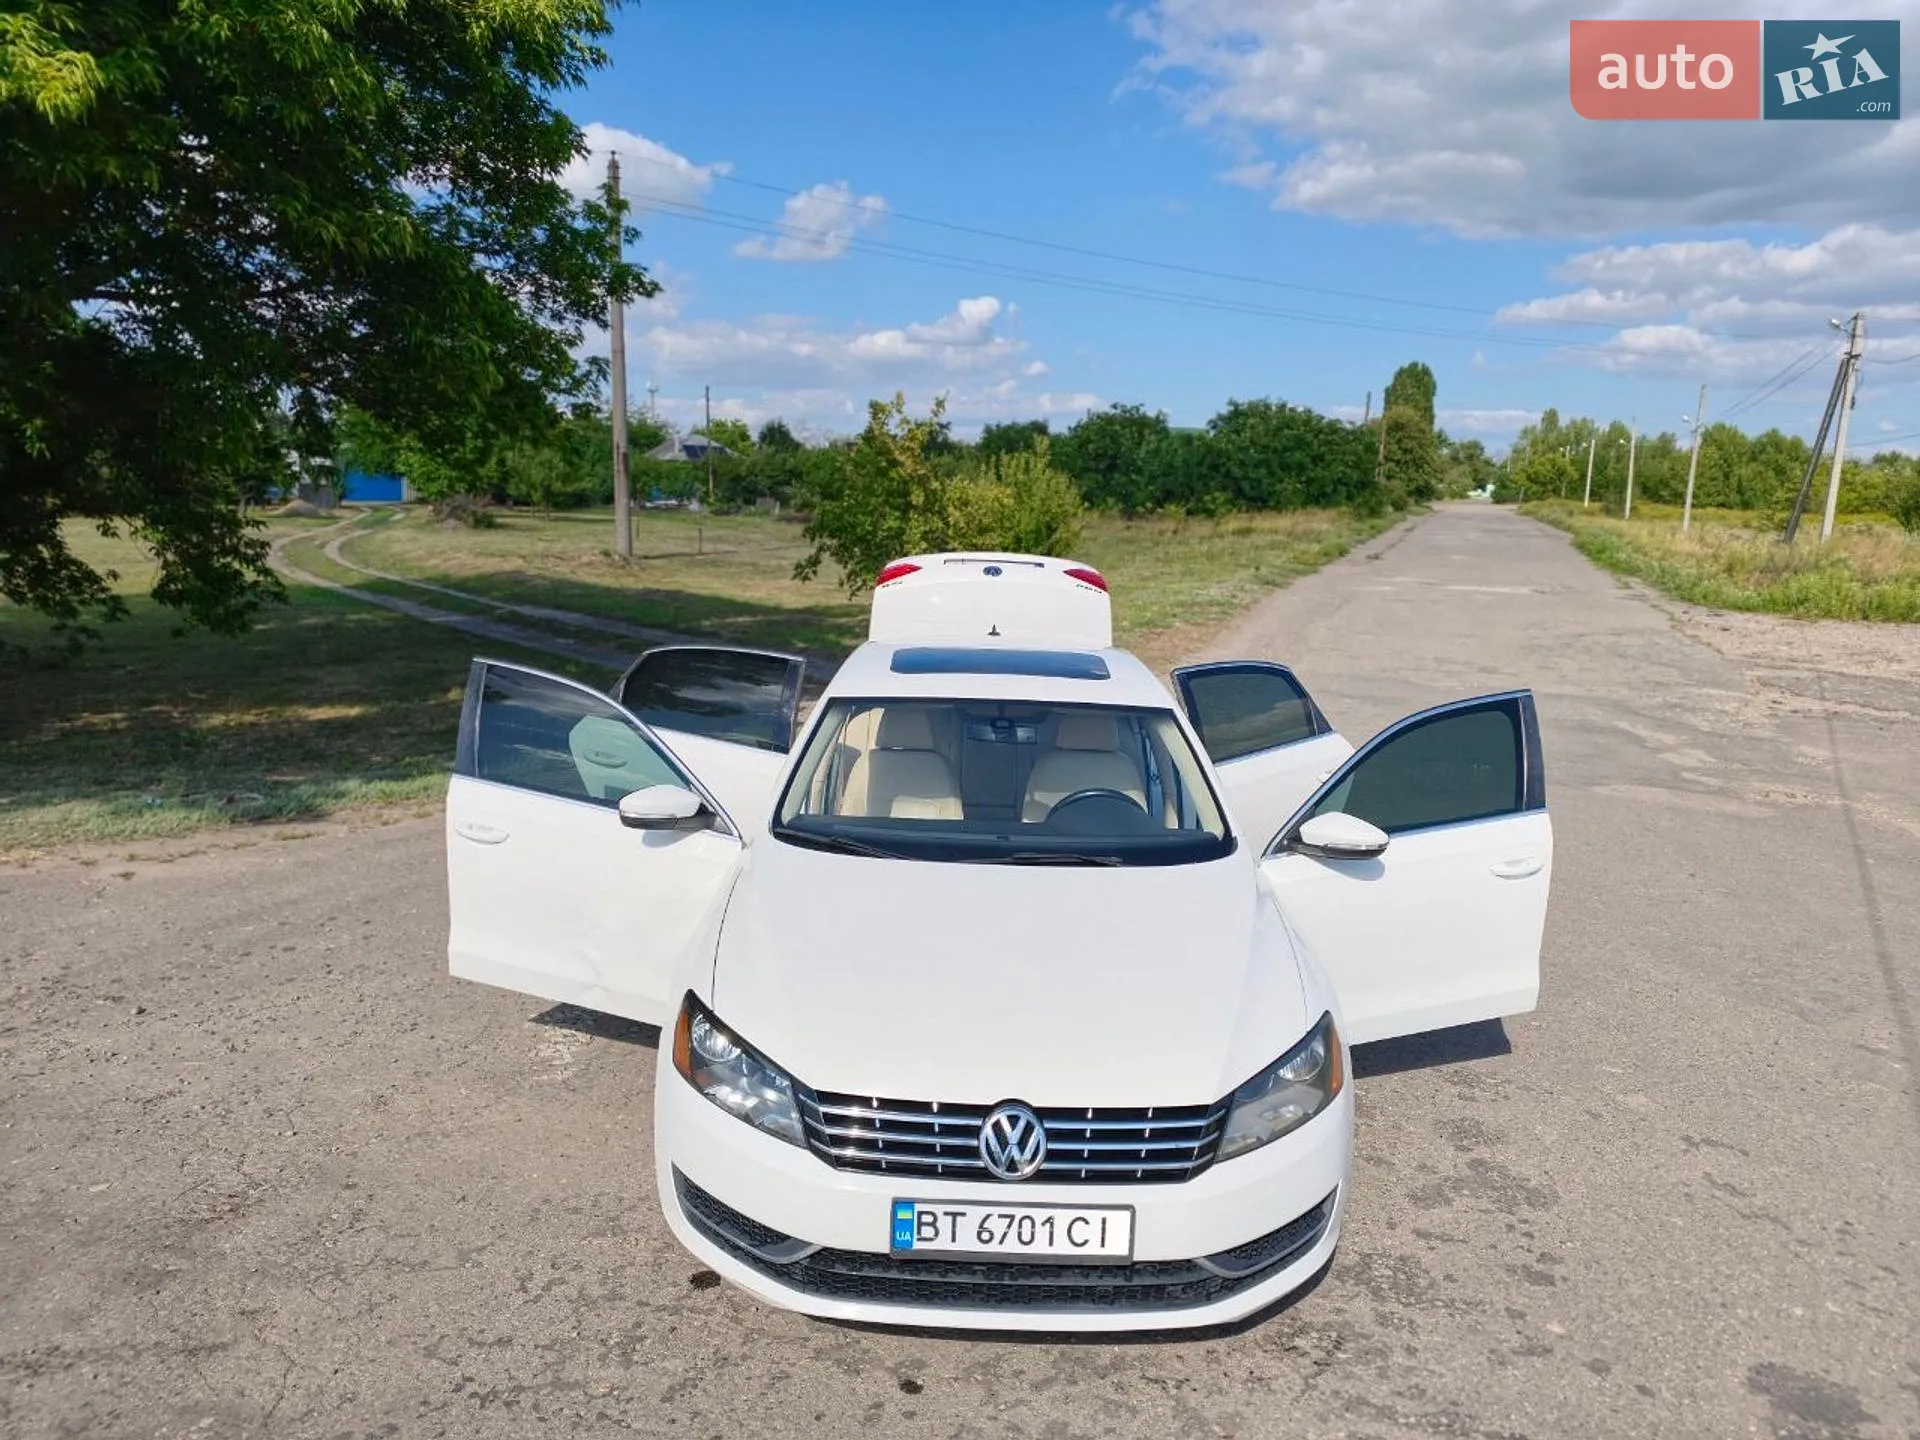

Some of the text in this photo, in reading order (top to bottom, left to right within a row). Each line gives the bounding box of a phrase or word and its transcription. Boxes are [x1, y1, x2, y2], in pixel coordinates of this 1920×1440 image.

[981, 1105, 1046, 1179] VW
[896, 1231, 912, 1242] UA
[916, 1210, 1107, 1248] BT 6701 CI
